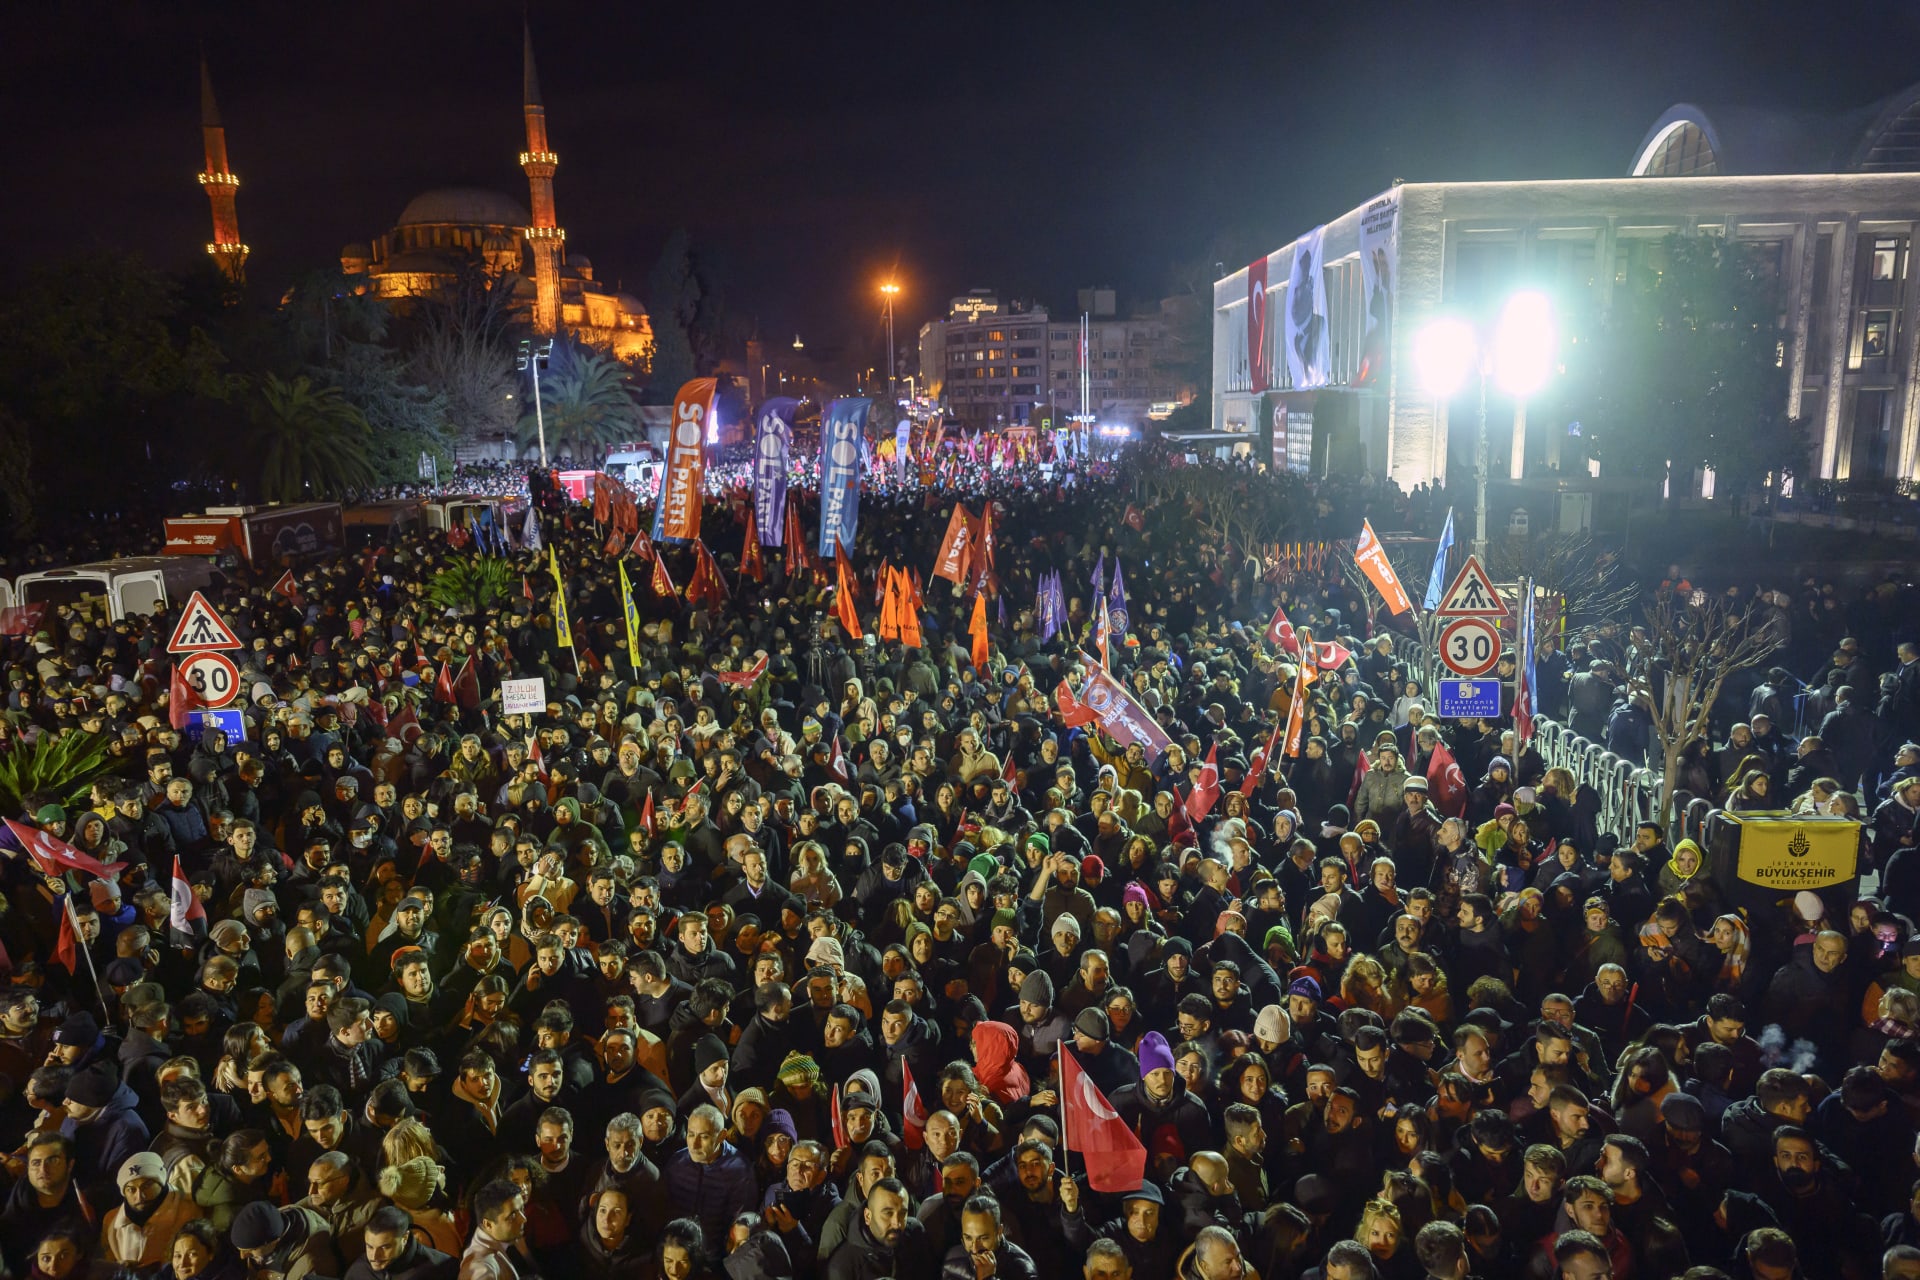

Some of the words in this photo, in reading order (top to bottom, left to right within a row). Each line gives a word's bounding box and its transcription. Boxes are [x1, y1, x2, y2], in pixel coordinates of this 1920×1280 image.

[1452, 636, 1490, 661] 30
[191, 667, 228, 693] 30
[1756, 865, 1836, 880] BÜYÜKŞEHİR
